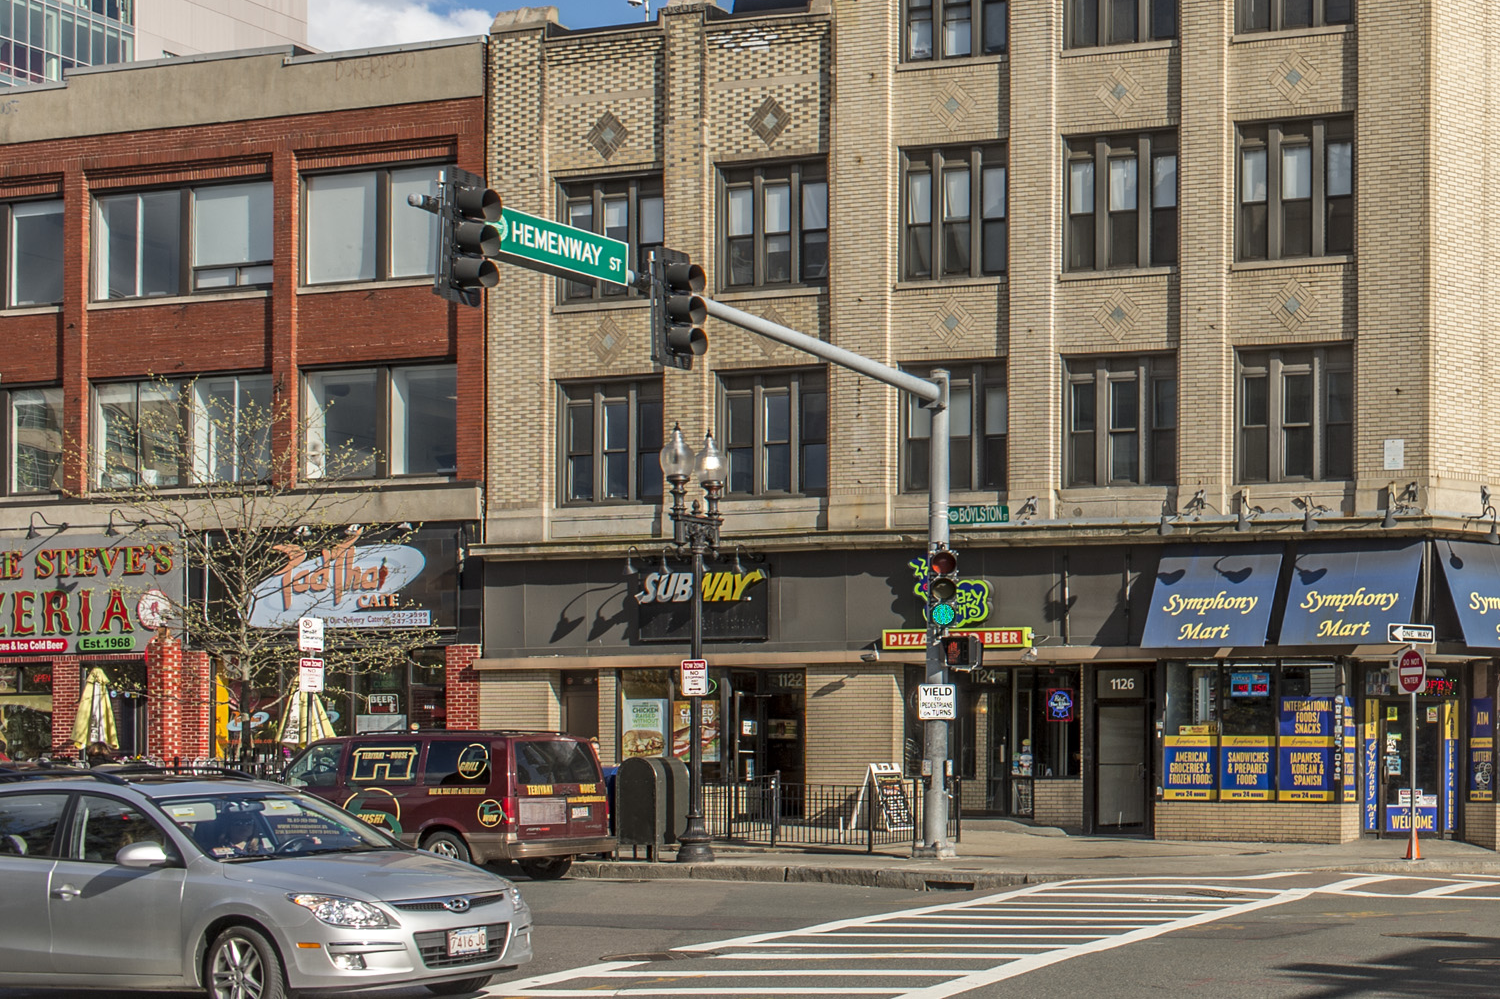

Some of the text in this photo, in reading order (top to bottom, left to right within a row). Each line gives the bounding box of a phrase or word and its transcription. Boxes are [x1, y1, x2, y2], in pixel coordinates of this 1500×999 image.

[511, 220, 622, 272] HEMENWAY ST
[958, 507, 1003, 523] BOYLSTON
[35, 544, 174, 579] STEVE'S
[1162, 591, 1258, 616] Symphony
[1300, 587, 1399, 613] Symphony
[1177, 622, 1230, 641] Mart
[1316, 619, 1371, 638] Mart
[1402, 630, 1415, 638] ONE
[83, 637, 131, 649] Est.1968
[889, 633, 928, 645] PIZZA
[984, 632, 1019, 644] BEER
[11, 641, 64, 650] & Ice Cold Beer
[1403, 657, 1421, 666] DO NOT
[33, 674, 51, 682] OPEN
[779, 673, 803, 687] 1122
[970, 670, 995, 683] 1124
[1404, 677, 1419, 685] ENTER
[1110, 678, 1135, 690] 1126
[922, 687, 952, 696] YIELD
[370, 695, 393, 703] BEER
[680, 708, 714, 716] CAED
[1283, 701, 1333, 712] INTERNATIONAL
[1295, 712, 1320, 723] FOODS/
[1476, 711, 1489, 725] ATM
[1294, 723, 1322, 734] SNACKS
[1175, 751, 1208, 762] AMERICAN
[1227, 751, 1269, 763] SANDWICHES
[1290, 752, 1324, 763] JAPANESE,
[1472, 751, 1492, 762] LOTTERY
[460, 761, 479, 771] GRILL
[1170, 762, 1211, 773] GROCERIES &
[1227, 763, 1268, 774] & PREPARED
[1291, 763, 1325, 775] KOREAN &
[1169, 773, 1213, 784] FROZEN FOODS
[1236, 774, 1258, 785] FOODS
[1293, 775, 1322, 786] SPANISH
[579, 784, 597, 793] HOUSE
[482, 814, 498, 822] WOK
[451, 935, 474, 949] 7416
